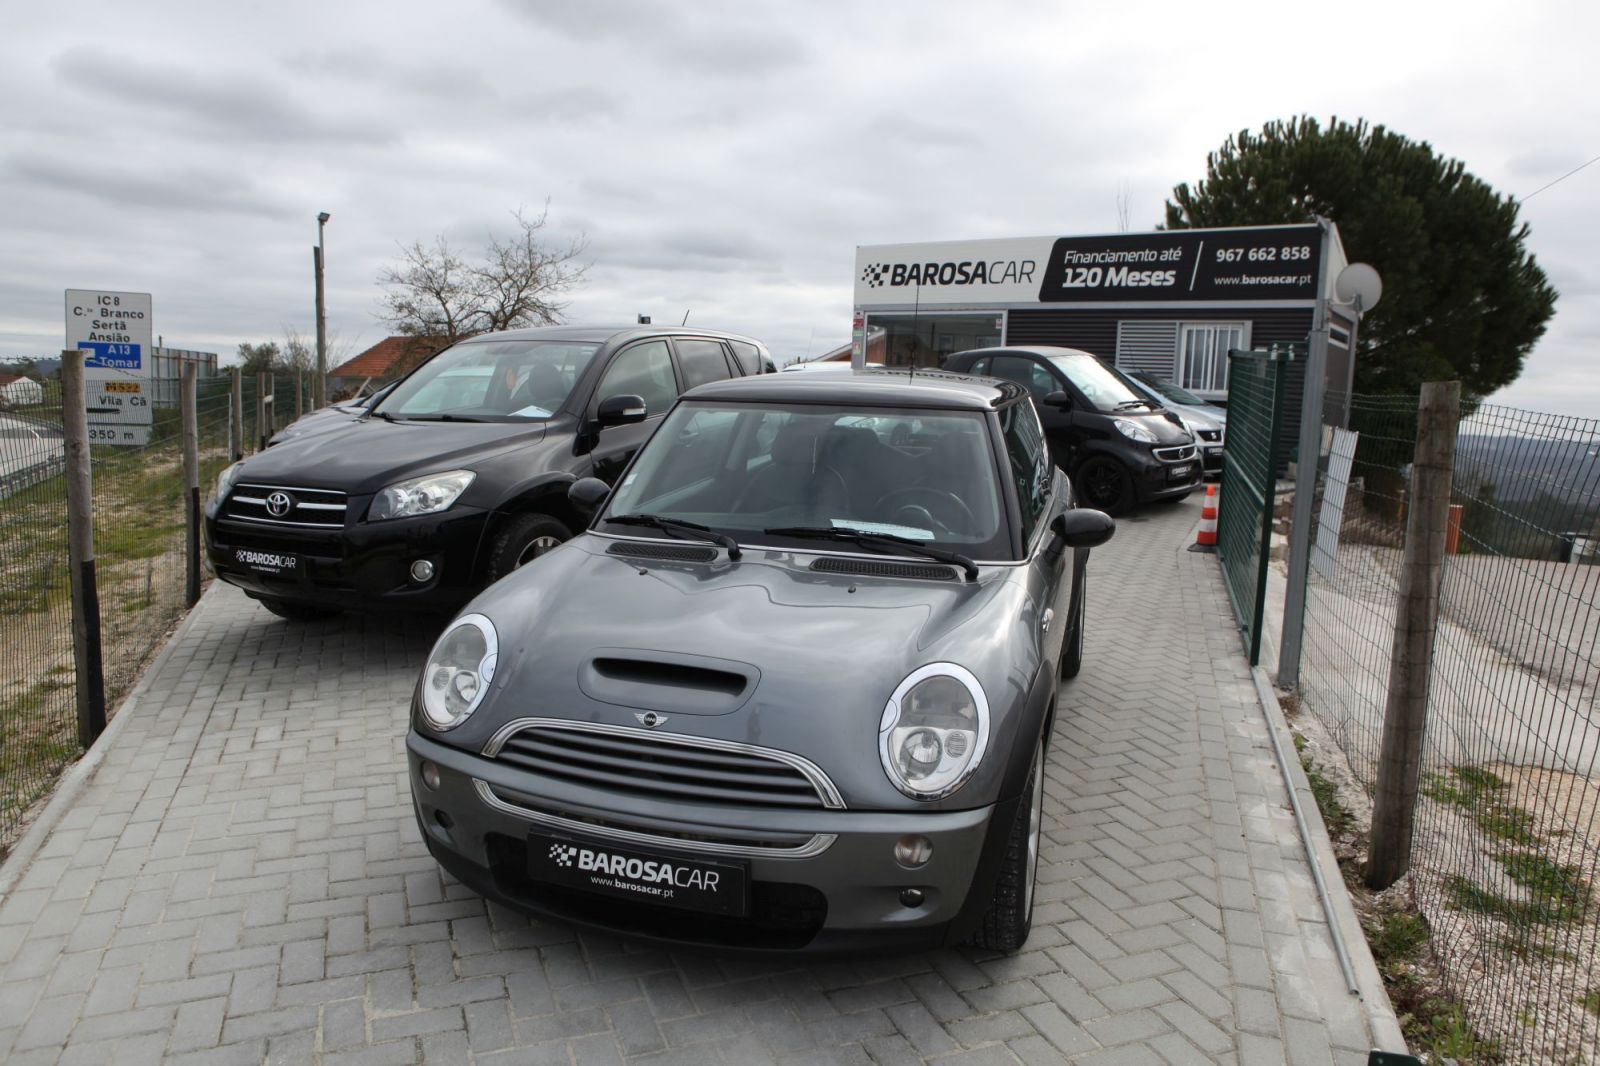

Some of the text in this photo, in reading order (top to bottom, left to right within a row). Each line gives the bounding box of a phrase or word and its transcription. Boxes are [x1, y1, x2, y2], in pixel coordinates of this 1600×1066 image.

[1064, 246, 1182, 264] Financiamento até
[1216, 246, 1310, 262] 967 662 858
[890, 260, 1036, 287] BAROSACAR
[1062, 266, 1177, 288] 120 Meses
[1214, 274, 1312, 286] www.barosacar.pt
[100, 307, 144, 319] Branco
[92, 319, 127, 331] Sertã
[88, 332, 130, 343] Ansião
[100, 356, 140, 368] Tomar
[100, 395, 122, 406] Vila
[89, 429, 134, 440] 350 m
[246, 551, 297, 569] BAROSACAR
[578, 849, 719, 892] BAROSACAR
[590, 875, 675, 898] www.barosacar.pt
